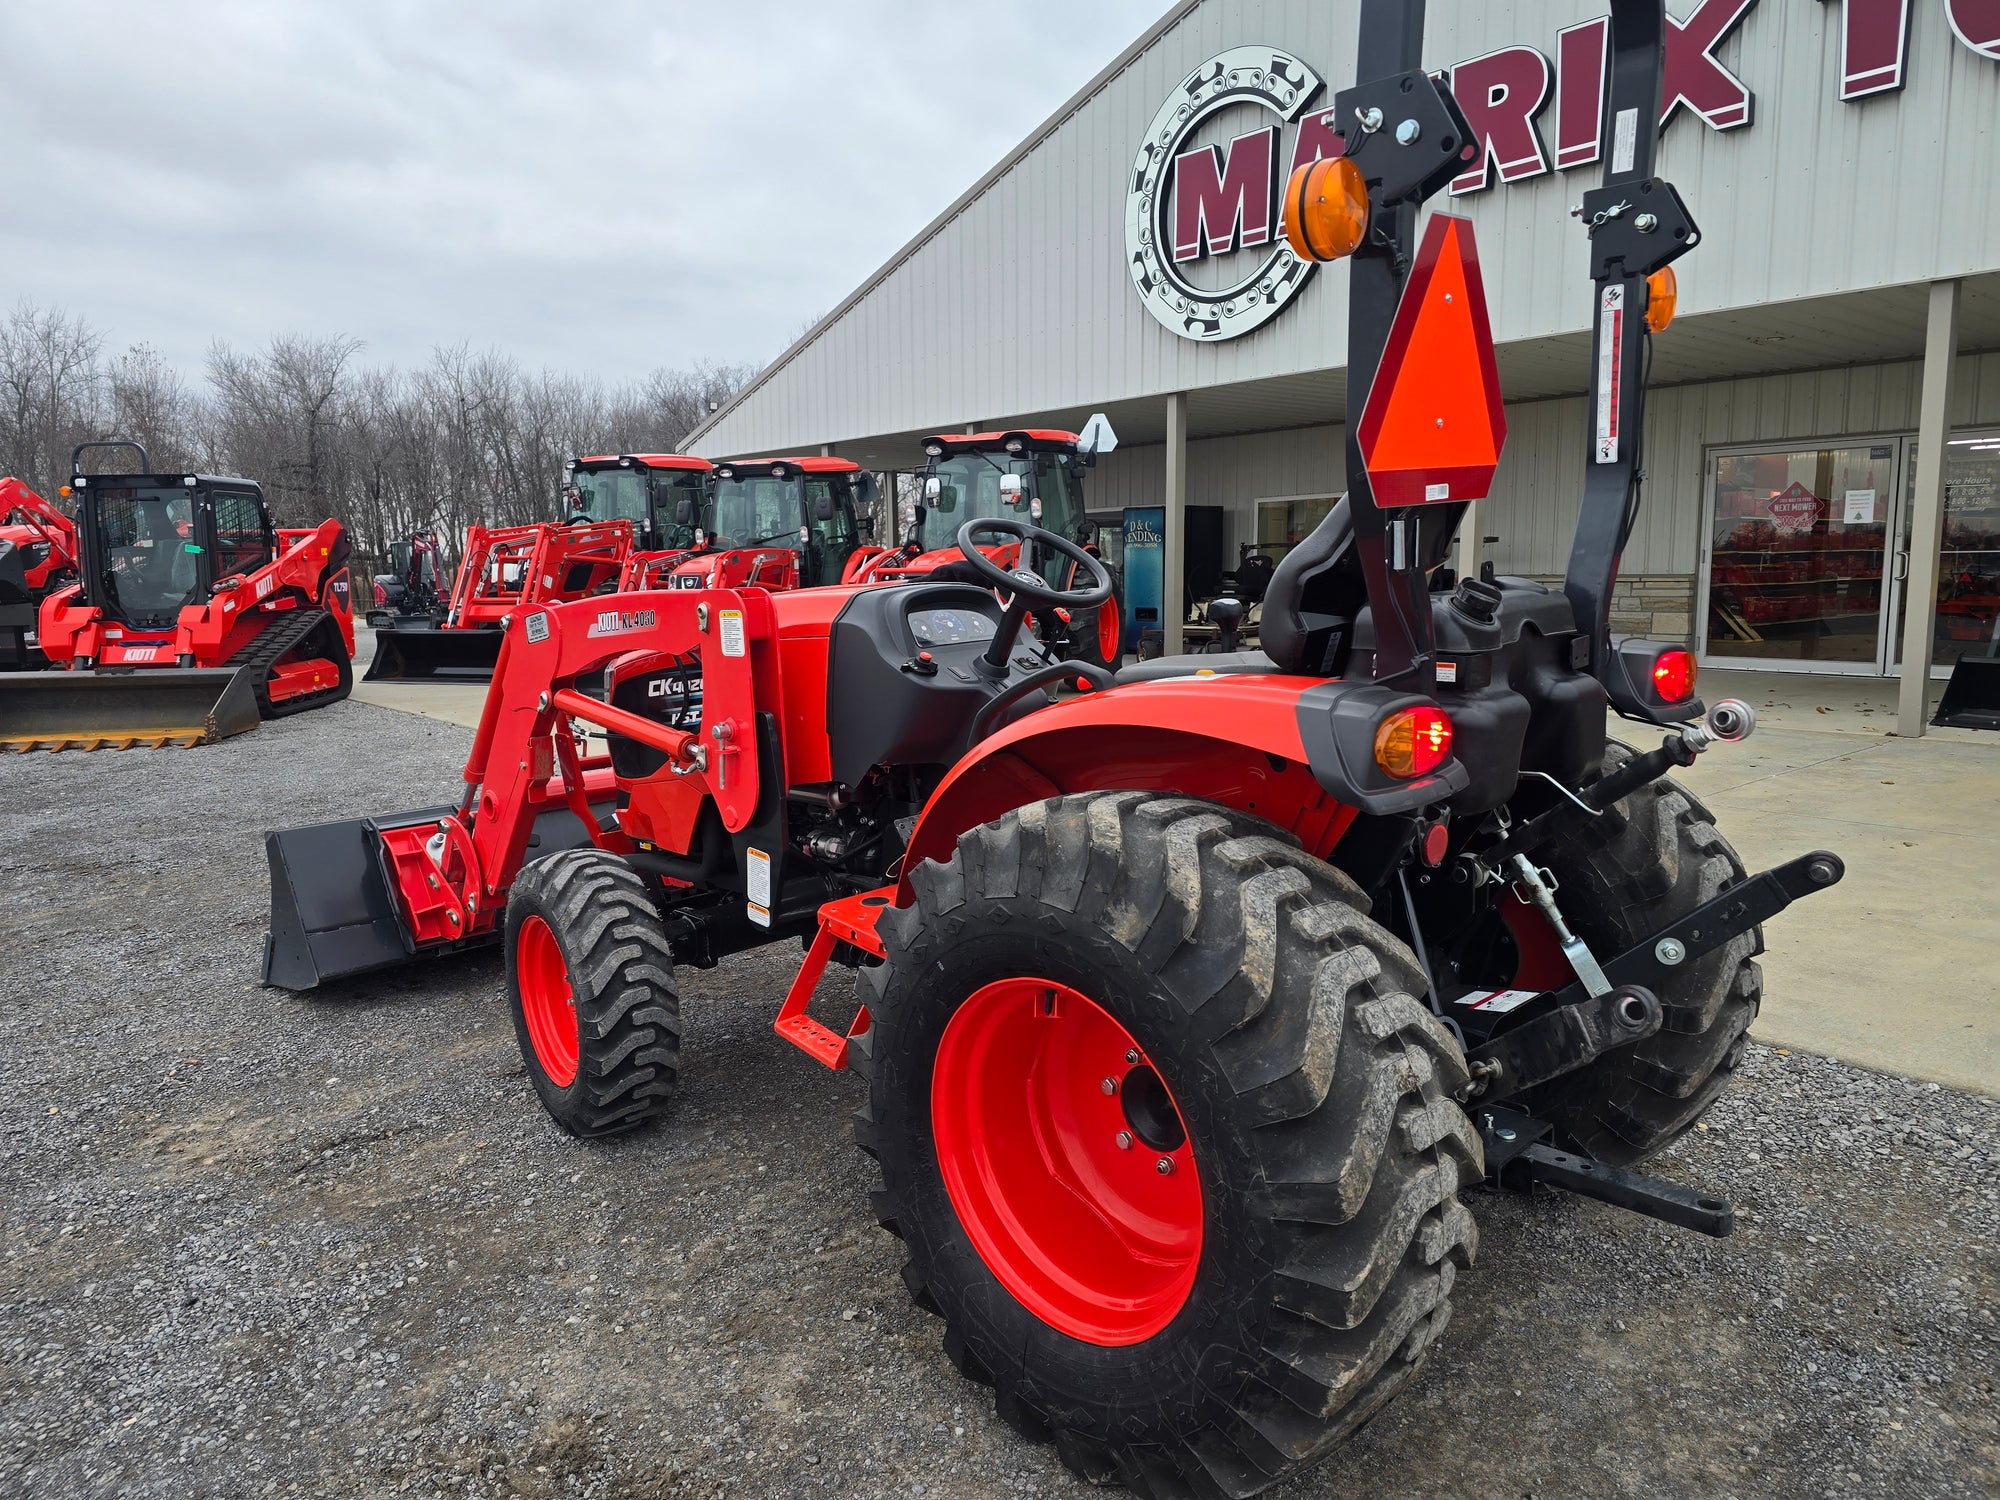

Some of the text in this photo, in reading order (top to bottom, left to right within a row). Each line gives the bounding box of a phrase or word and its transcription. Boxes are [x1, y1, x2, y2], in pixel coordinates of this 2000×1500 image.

[1173, 0, 1760, 264] MRIX
[1609, 336, 1621, 432] DANGER
[1774, 502, 1817, 512] NEXT MOWER
[1130, 520, 1136, 532] D
[1145, 520, 1152, 531] C
[1124, 531, 1162, 543] VENDING
[255, 573, 274, 599] KIOTI
[333, 582, 348, 592] TL750
[597, 609, 656, 632] KIOTI KL 4030
[122, 648, 157, 662] KIOTI
